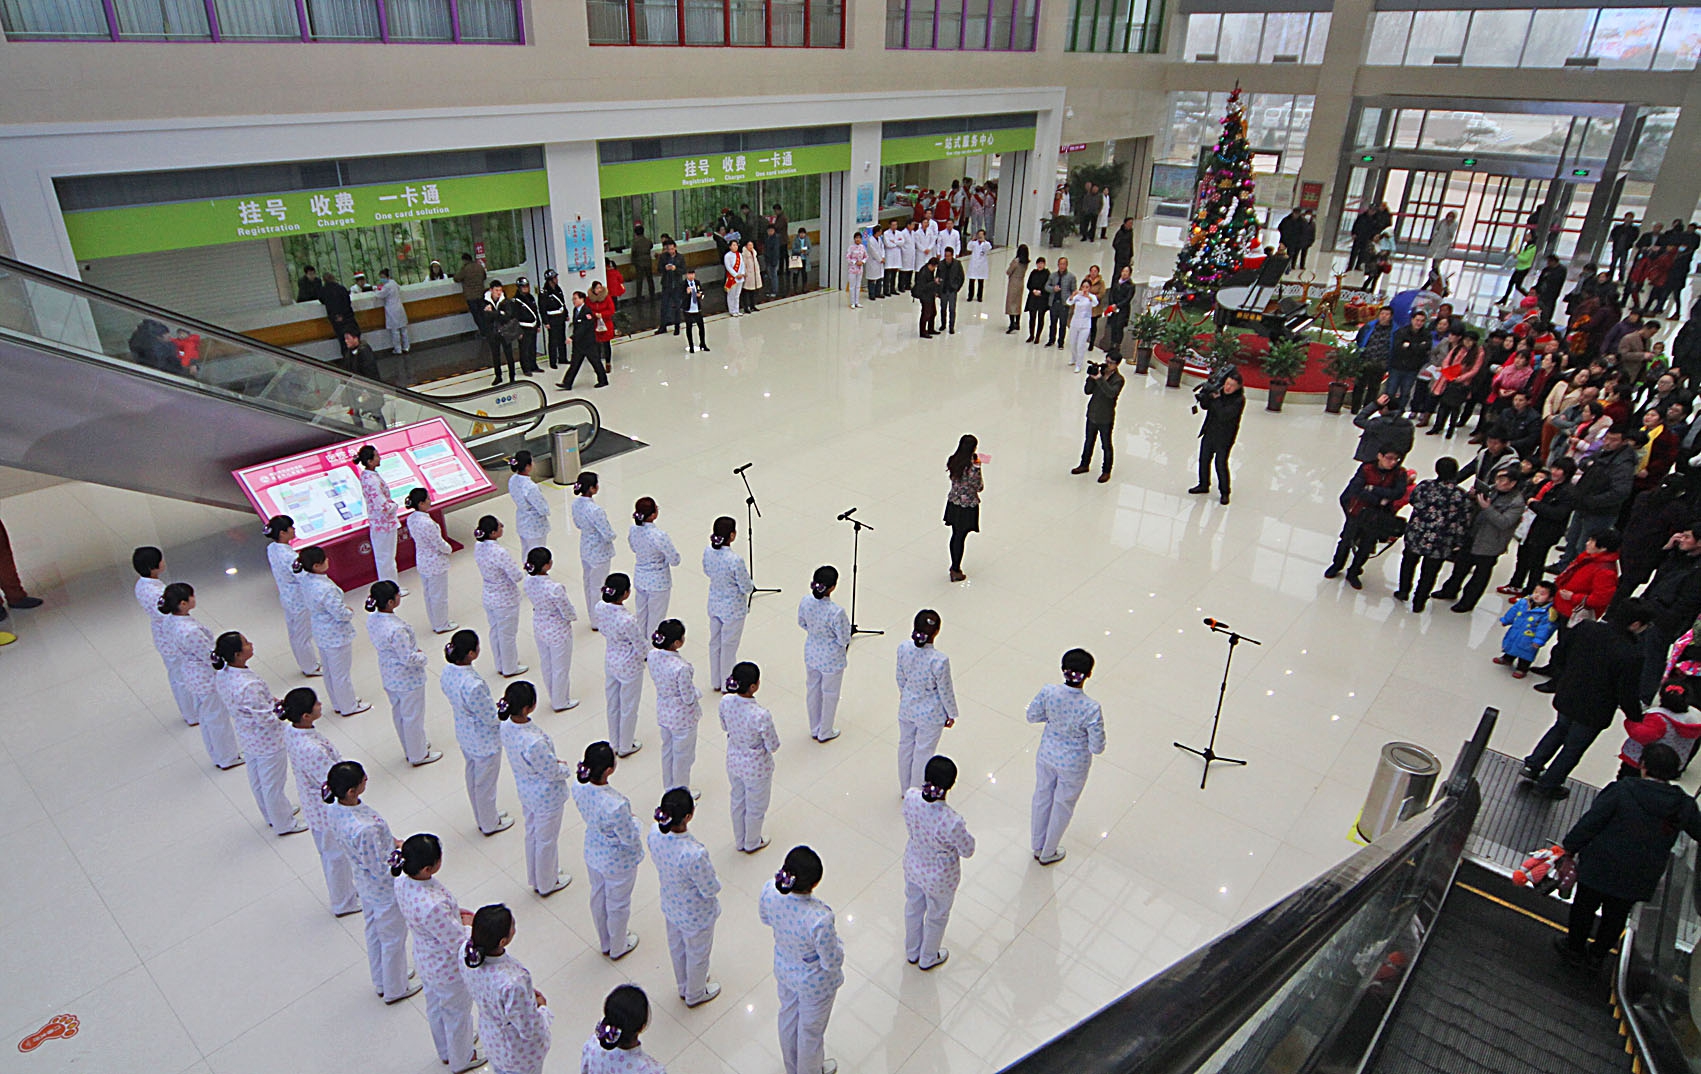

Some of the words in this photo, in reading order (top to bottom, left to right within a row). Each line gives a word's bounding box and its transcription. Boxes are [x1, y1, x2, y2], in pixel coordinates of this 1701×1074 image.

[934, 132, 994, 150] 一站式服务中心
[684, 159, 710, 178] 挂号
[722, 155, 747, 173] 收费
[758, 151, 793, 168] 一卡通
[682, 176, 716, 186] Registration
[724, 173, 746, 181] Charges
[237, 198, 288, 225] 挂号
[310, 191, 355, 217] 收费
[378, 183, 441, 208] 一卡通
[236, 222, 301, 237] Registration
[317, 217, 356, 228] Charges
[374, 212, 393, 221] One
[394, 209, 414, 219] card
[415, 206, 450, 217] solution
